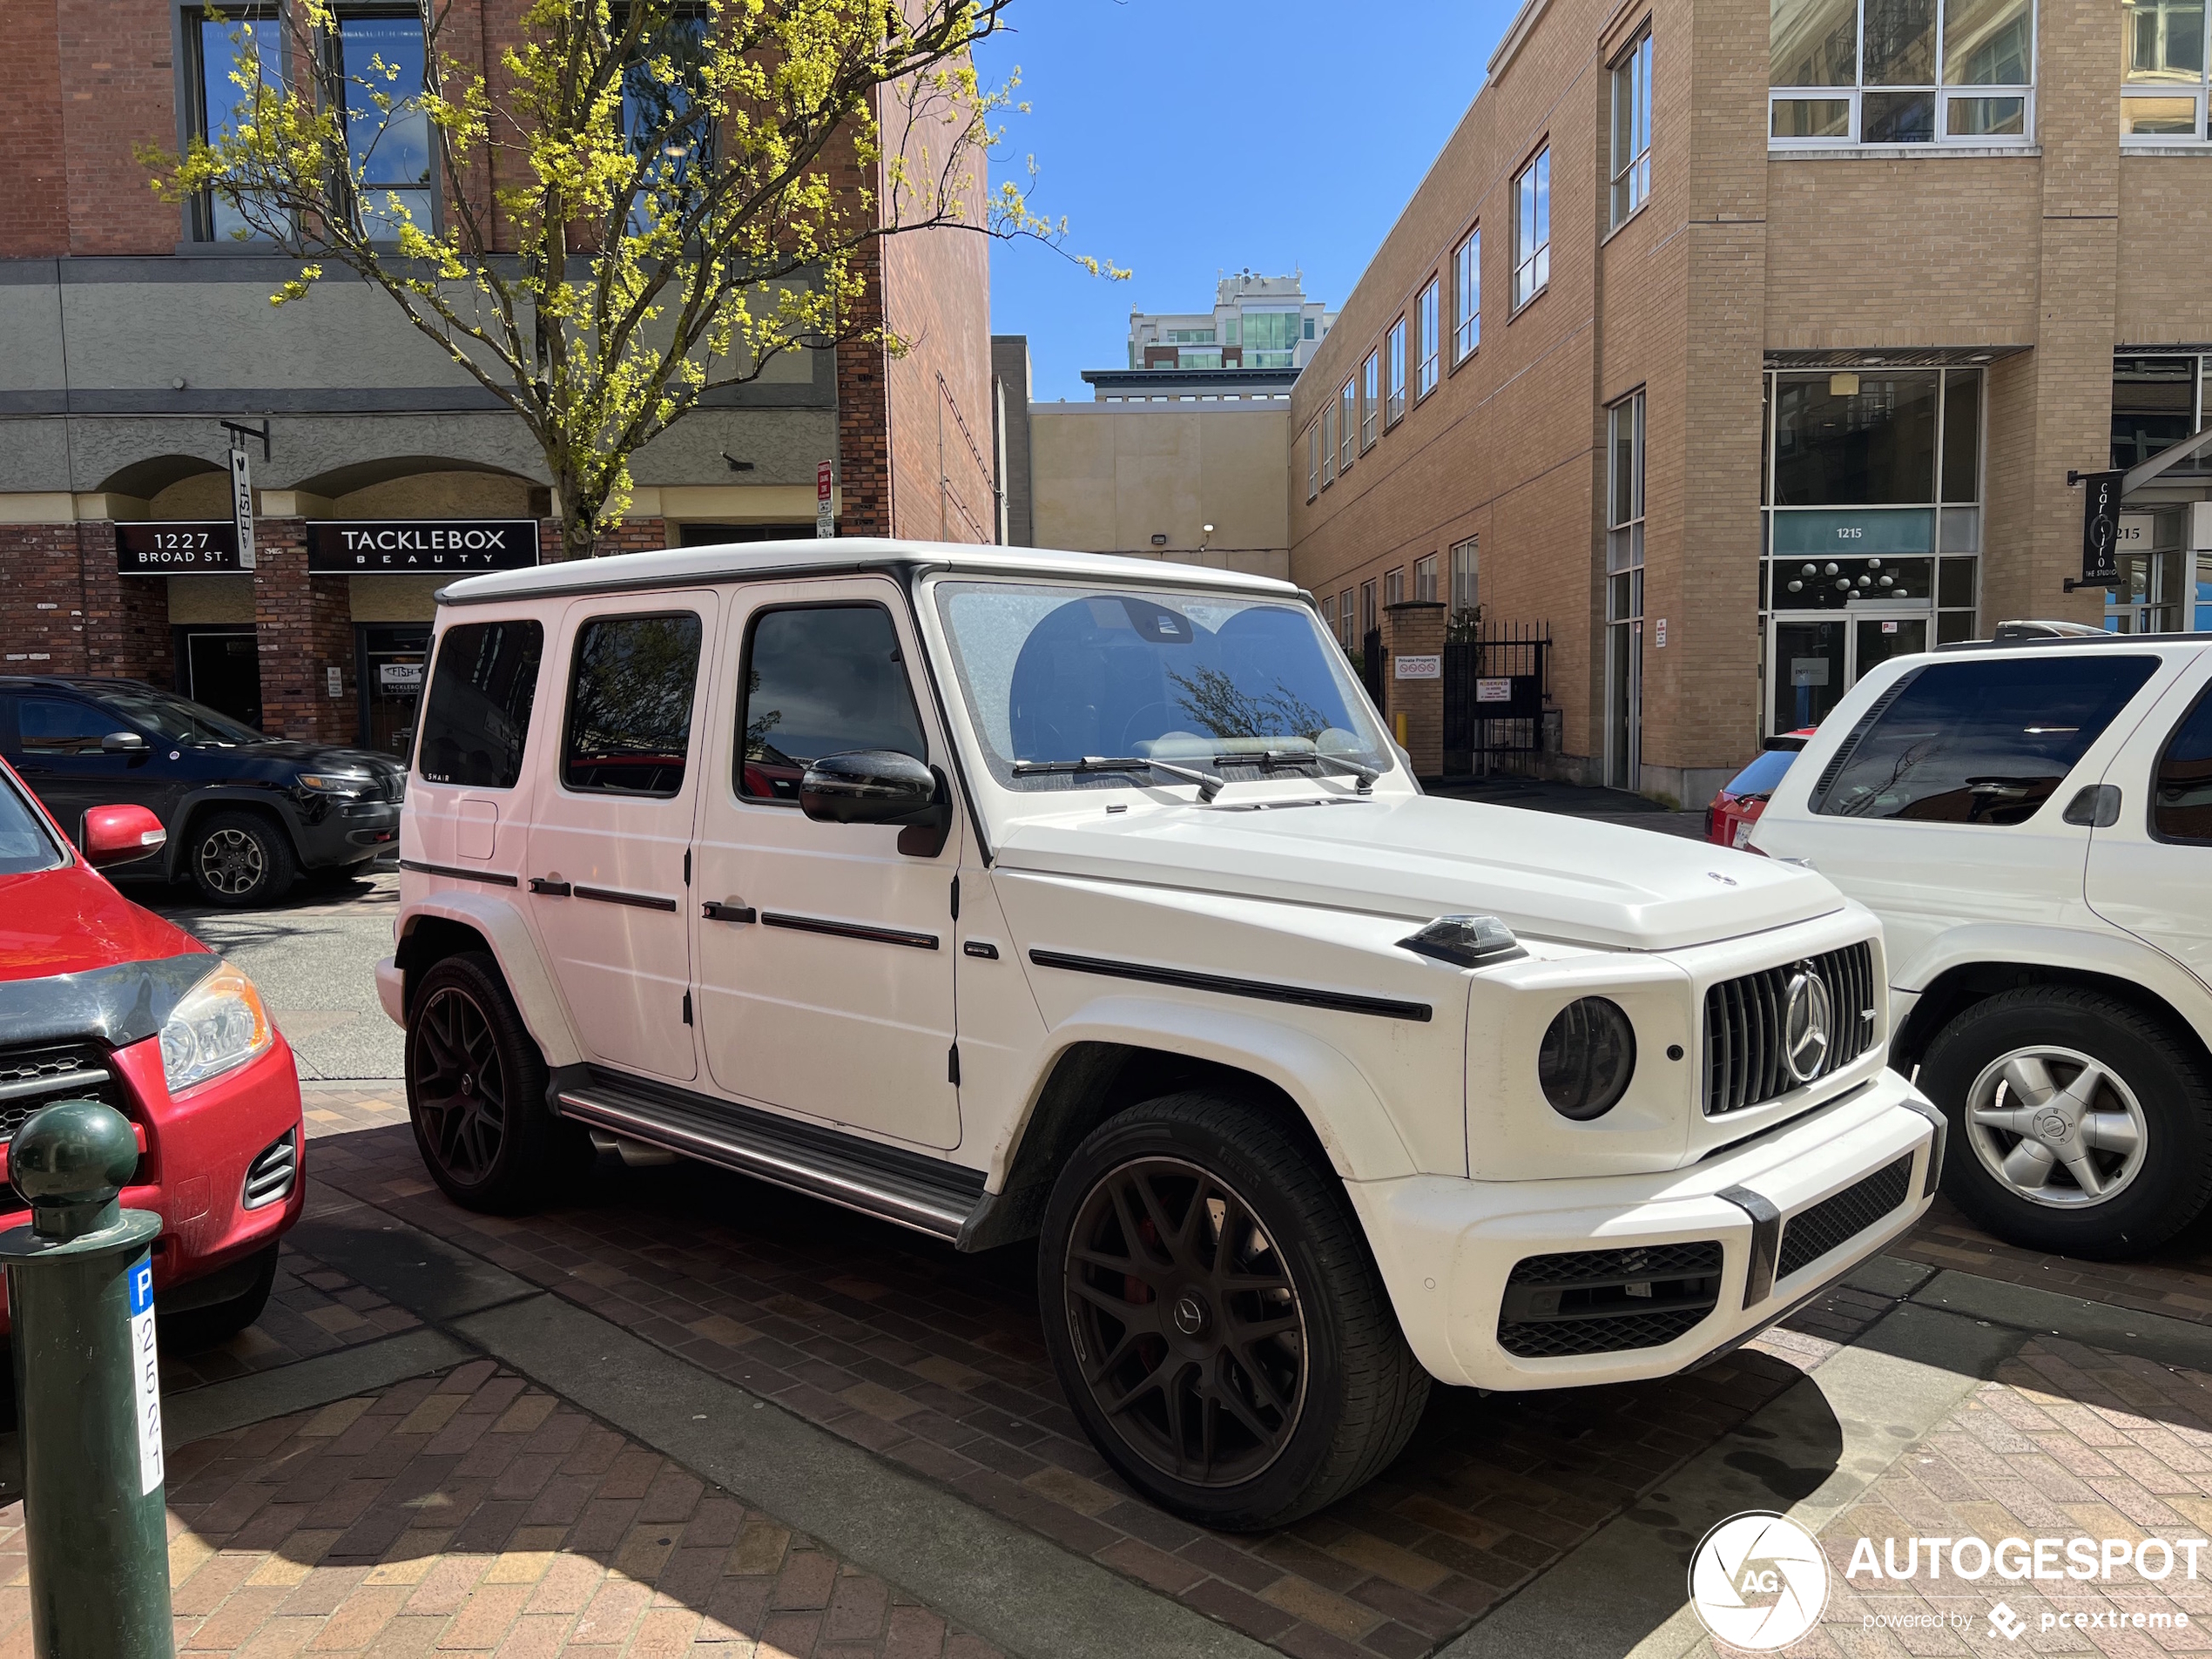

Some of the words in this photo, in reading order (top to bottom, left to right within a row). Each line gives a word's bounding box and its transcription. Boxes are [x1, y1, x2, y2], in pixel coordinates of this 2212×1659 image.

[239, 483, 251, 530] FISH
[1836, 527, 1863, 538] 1215
[2116, 527, 2141, 539] 215
[154, 532, 209, 550] 1227
[341, 529, 506, 550] TACKLEBOX
[138, 550, 195, 563] BROAD
[204, 550, 229, 563] ST.
[356, 554, 493, 564] BEAUTY
[2097, 568, 2117, 577] STUDIO
[392, 666, 414, 677] FISH
[137, 1268, 152, 1307] P
[141, 1317, 161, 1476] 2521
